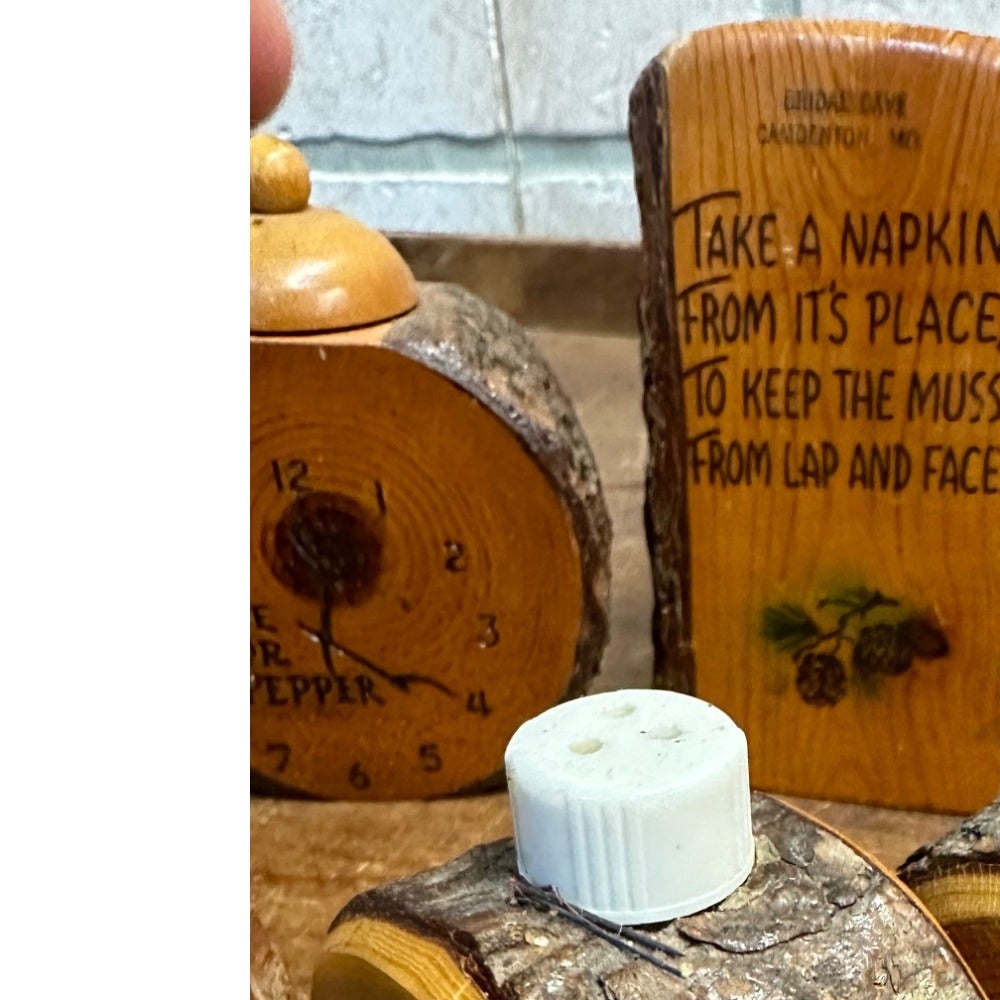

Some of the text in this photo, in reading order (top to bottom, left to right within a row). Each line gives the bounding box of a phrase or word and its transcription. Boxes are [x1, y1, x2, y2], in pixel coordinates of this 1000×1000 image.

[672, 190, 778, 268] TAKE
[798, 216, 822, 266] A
[676, 275, 777, 346] FROM
[796, 280, 848, 345] IT'S
[683, 356, 729, 418] TO
[743, 369, 821, 419] KEEP
[833, 369, 896, 420] THE
[271, 459, 312, 492] 12
[687, 429, 773, 487] FROM
[785, 441, 839, 488] LAP
[849, 442, 911, 491] AND
[443, 538, 467, 572] 2
[478, 614, 500, 648] 3
[465, 690, 493, 718] 4
[265, 743, 291, 773] 7
[418, 743, 443, 774] 5
[350, 762, 371, 791] 6
